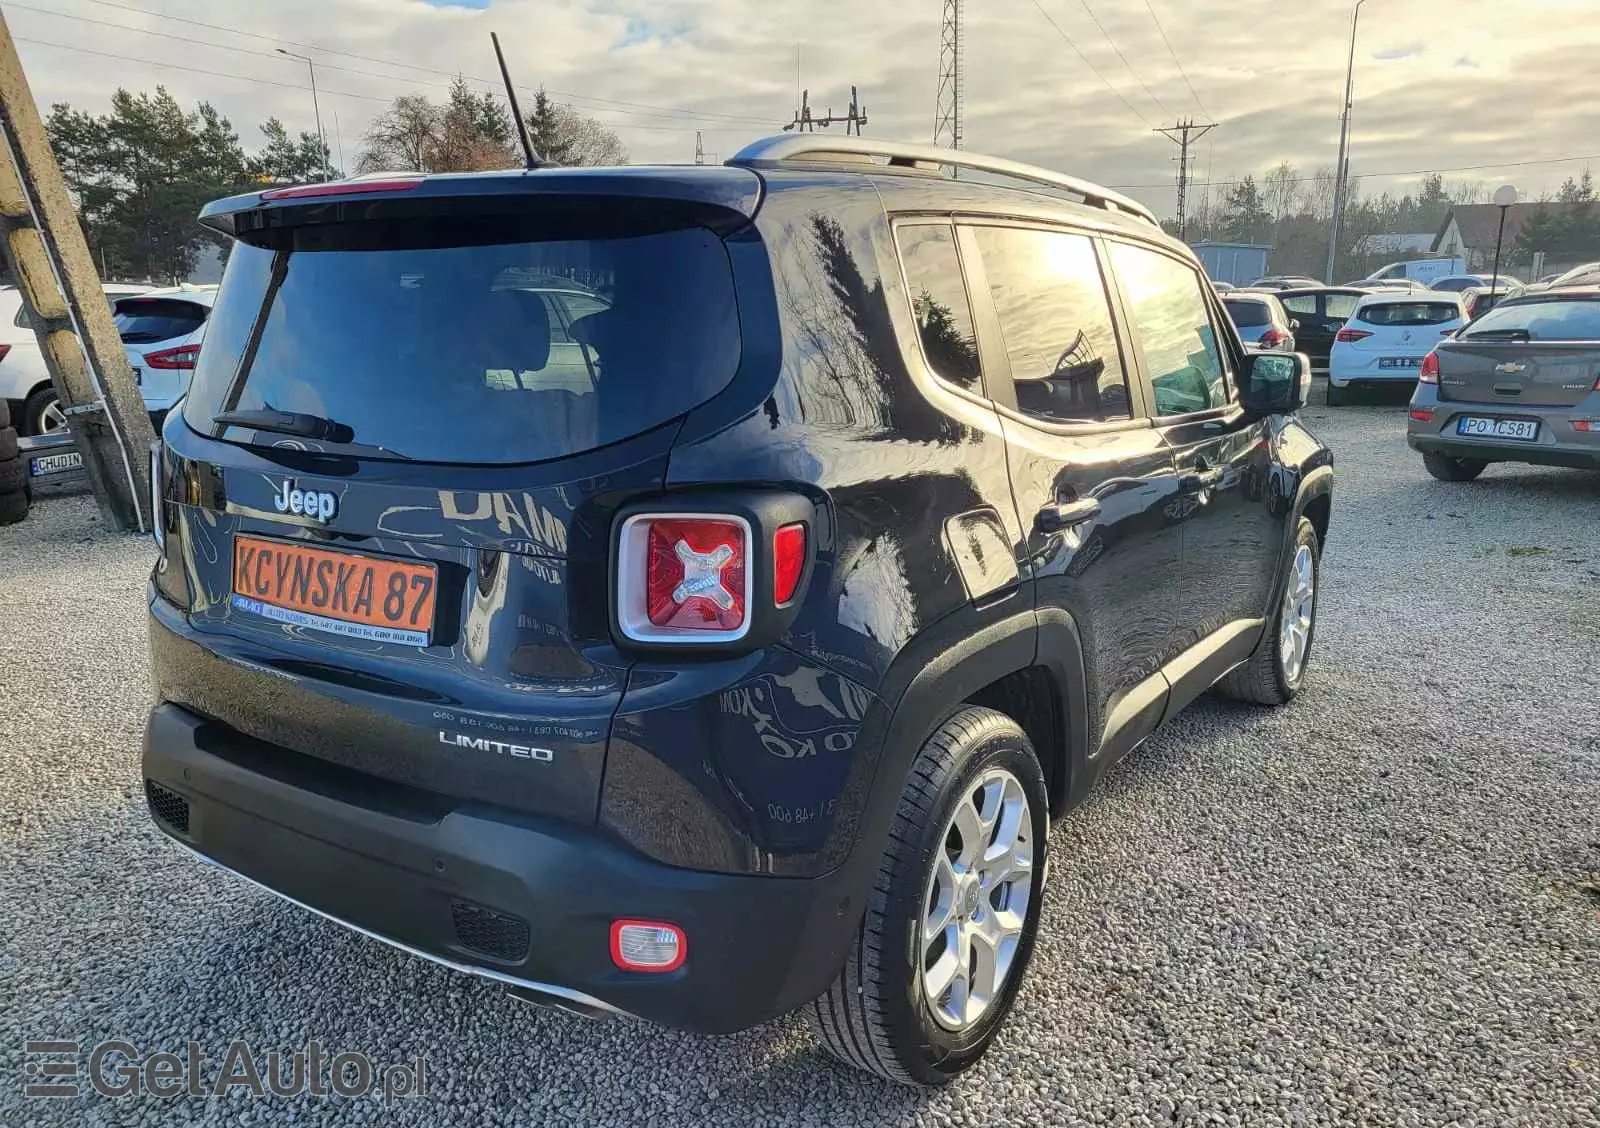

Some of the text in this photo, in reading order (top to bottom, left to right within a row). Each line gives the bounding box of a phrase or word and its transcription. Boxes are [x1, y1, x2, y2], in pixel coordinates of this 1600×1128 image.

[1467, 419, 1534, 437] PO 1CS81
[274, 477, 338, 523] Jeep
[237, 545, 434, 625] KCYNSKA 87
[439, 730, 553, 762] LIMITED
